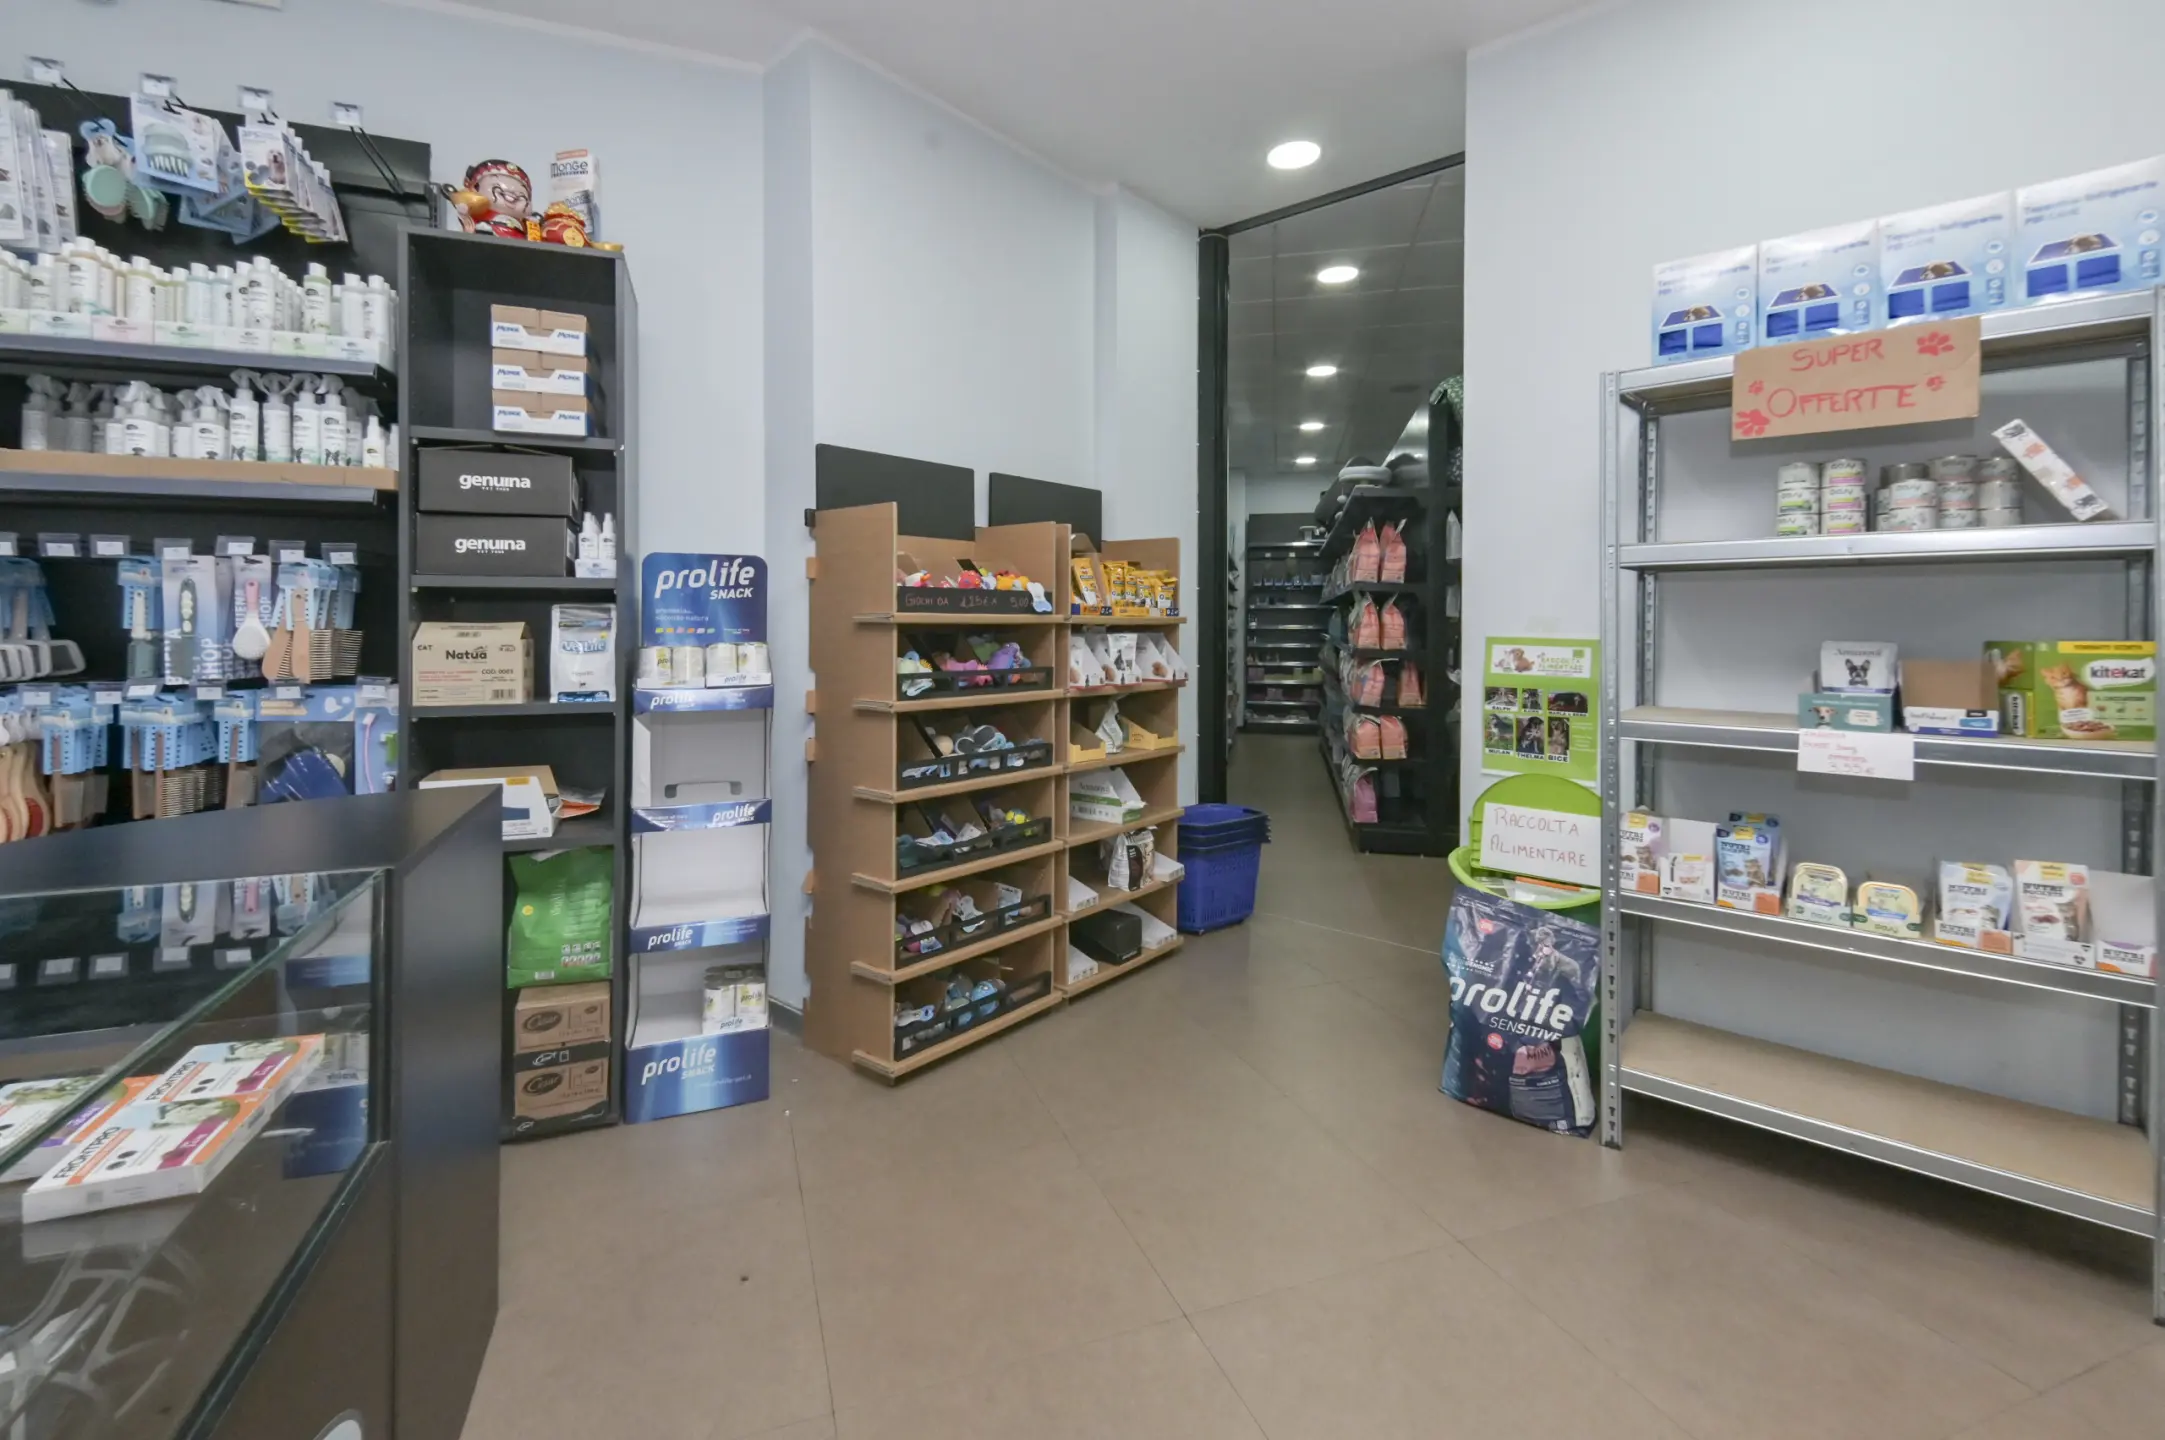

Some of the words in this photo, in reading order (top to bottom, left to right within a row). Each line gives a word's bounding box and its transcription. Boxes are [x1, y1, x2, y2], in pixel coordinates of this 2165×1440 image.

[1791, 338, 1884, 372] SUPER
[1767, 384, 1917, 418] OFFERTE
[459, 474, 531, 490] genuina
[455, 537, 526, 553] genuina
[654, 558, 756, 599] prolife
[709, 587, 754, 600] SNACK
[445, 650, 488, 660] Natua
[2090, 665, 2146, 679] kitekat
[650, 692, 697, 710] prolife
[712, 803, 756, 825] prolife
[1494, 807, 1579, 837] RACCOLTA
[1490, 834, 1588, 867] ALIMENTARE
[647, 928, 694, 950] prolife
[720, 1017, 743, 1029] prolife
[641, 1043, 717, 1086] prolife
[681, 1064, 715, 1080] SNACK
[146, 1060, 198, 1101] FRONTPRO
[53, 1125, 122, 1179] FRONTPRO
